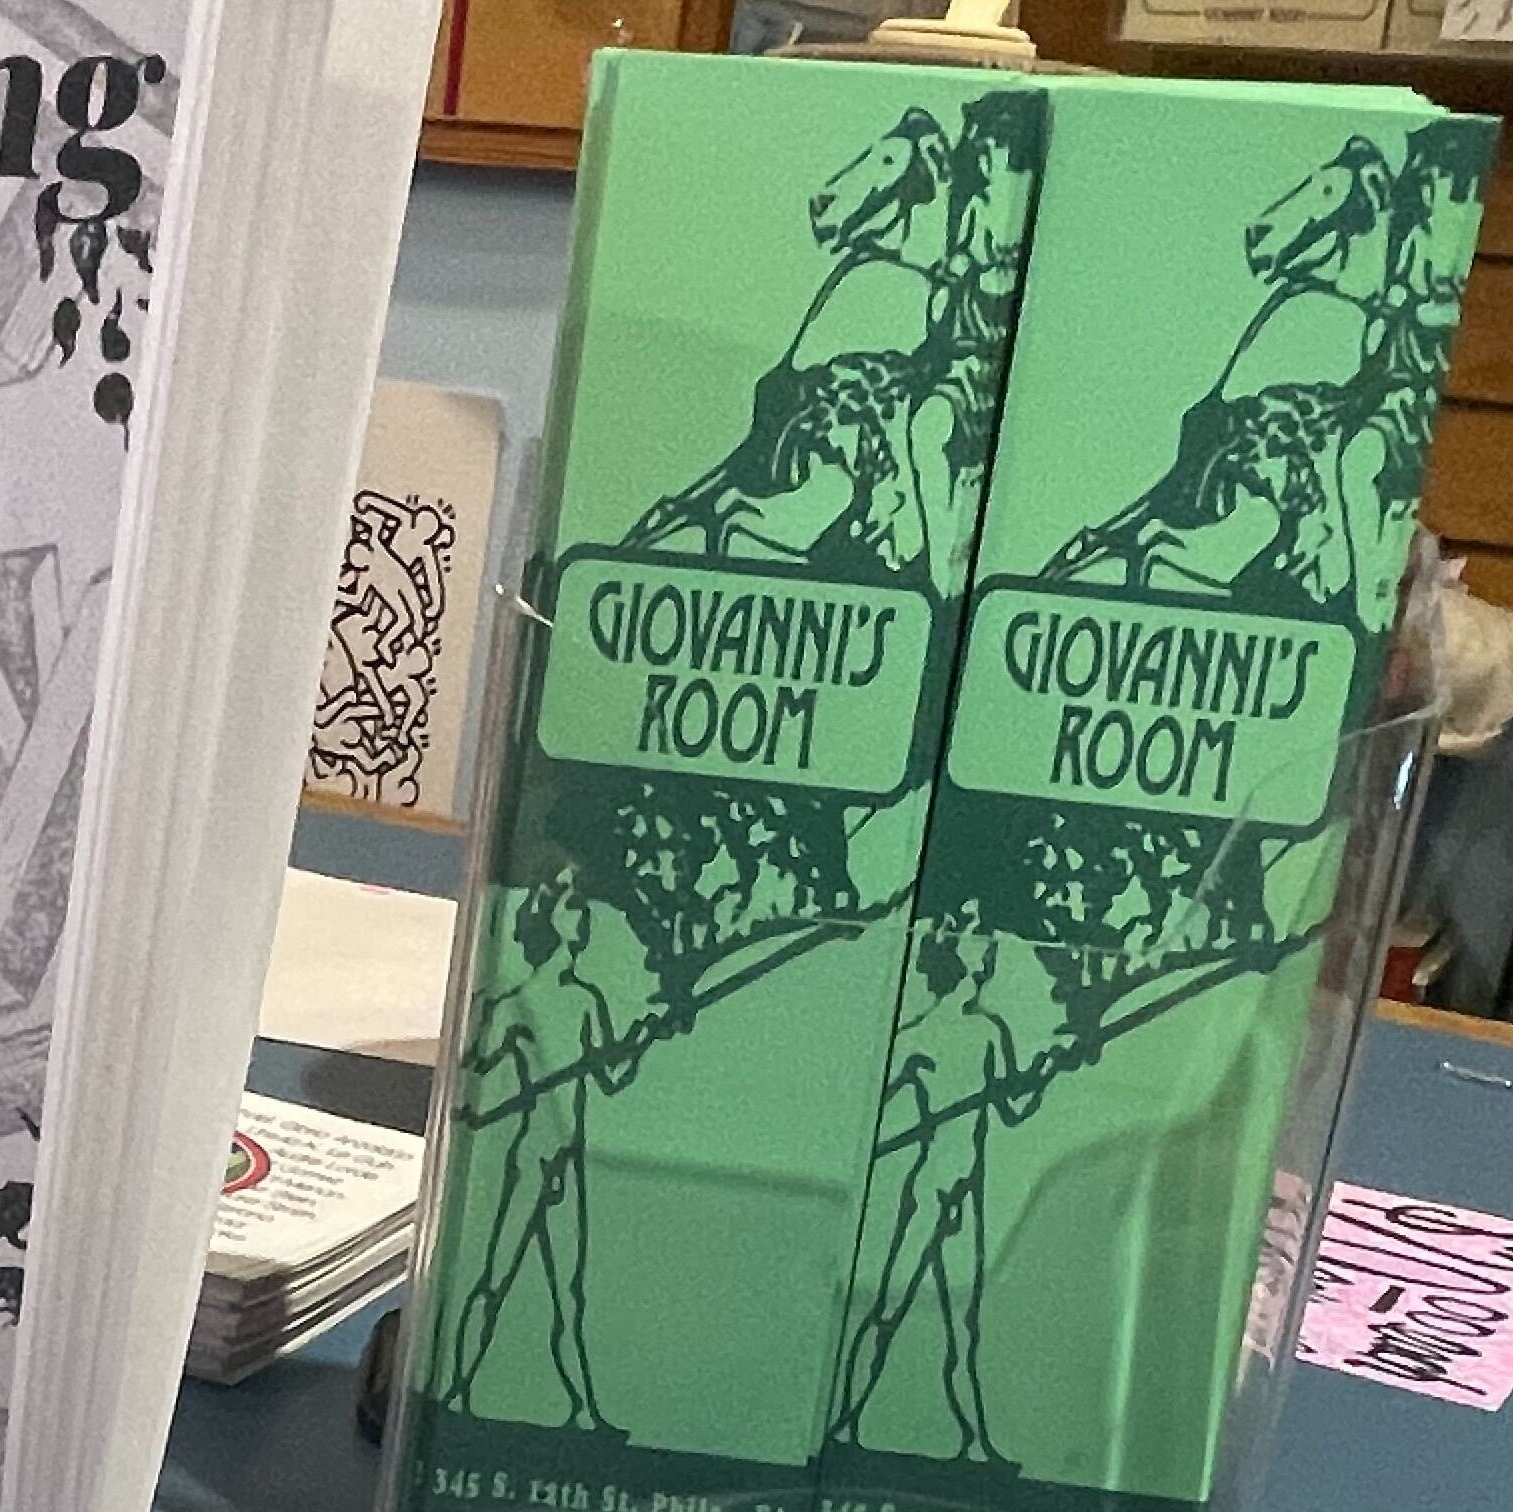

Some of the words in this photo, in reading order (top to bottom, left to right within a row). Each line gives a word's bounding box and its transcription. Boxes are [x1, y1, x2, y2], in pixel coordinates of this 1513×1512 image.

[589, 580, 897, 688] GIOVANNI'S
[1004, 610, 1320, 721] GIOVANNI'S
[636, 673, 818, 769] ROOM
[1049, 704, 1237, 802] ROOM
[432, 1467, 481, 1498] 345
[492, 1470, 516, 1500] S.
